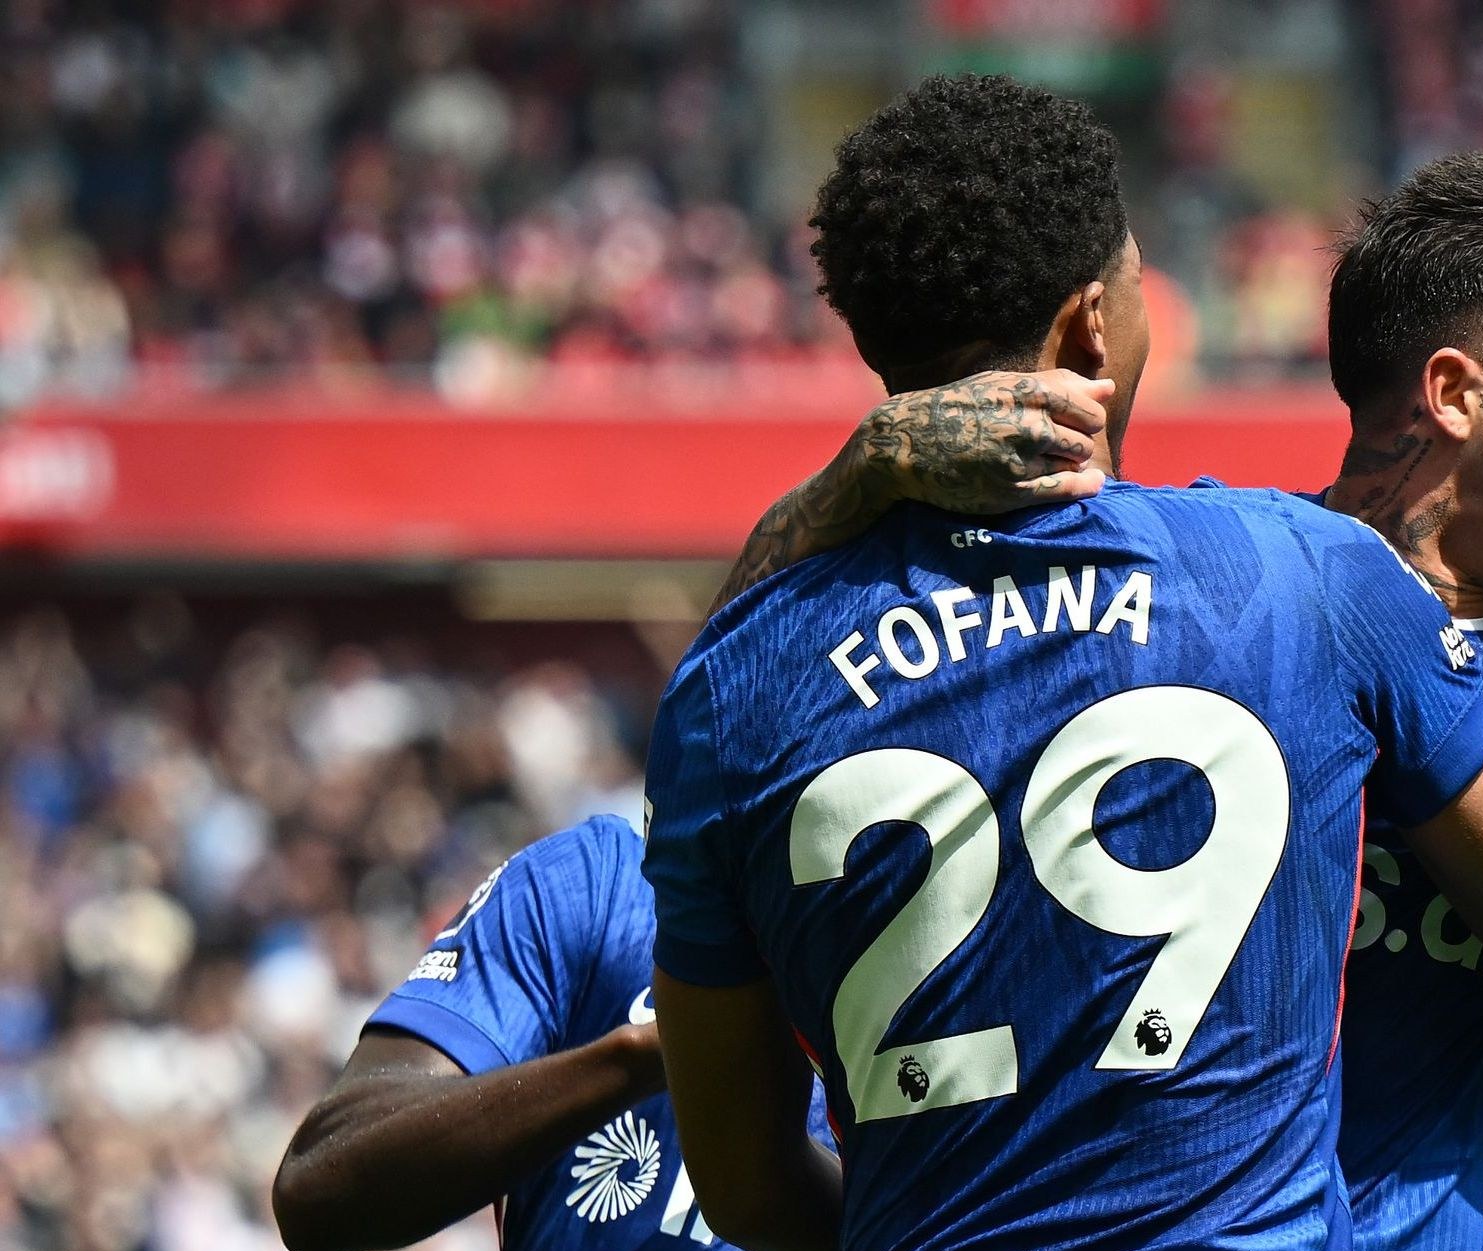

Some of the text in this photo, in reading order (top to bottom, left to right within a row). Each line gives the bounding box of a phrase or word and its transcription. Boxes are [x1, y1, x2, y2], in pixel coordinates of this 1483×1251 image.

[950, 528, 993, 548] CFC
[828, 565, 1153, 710] FOFANA
[788, 684, 1291, 1123] 29
